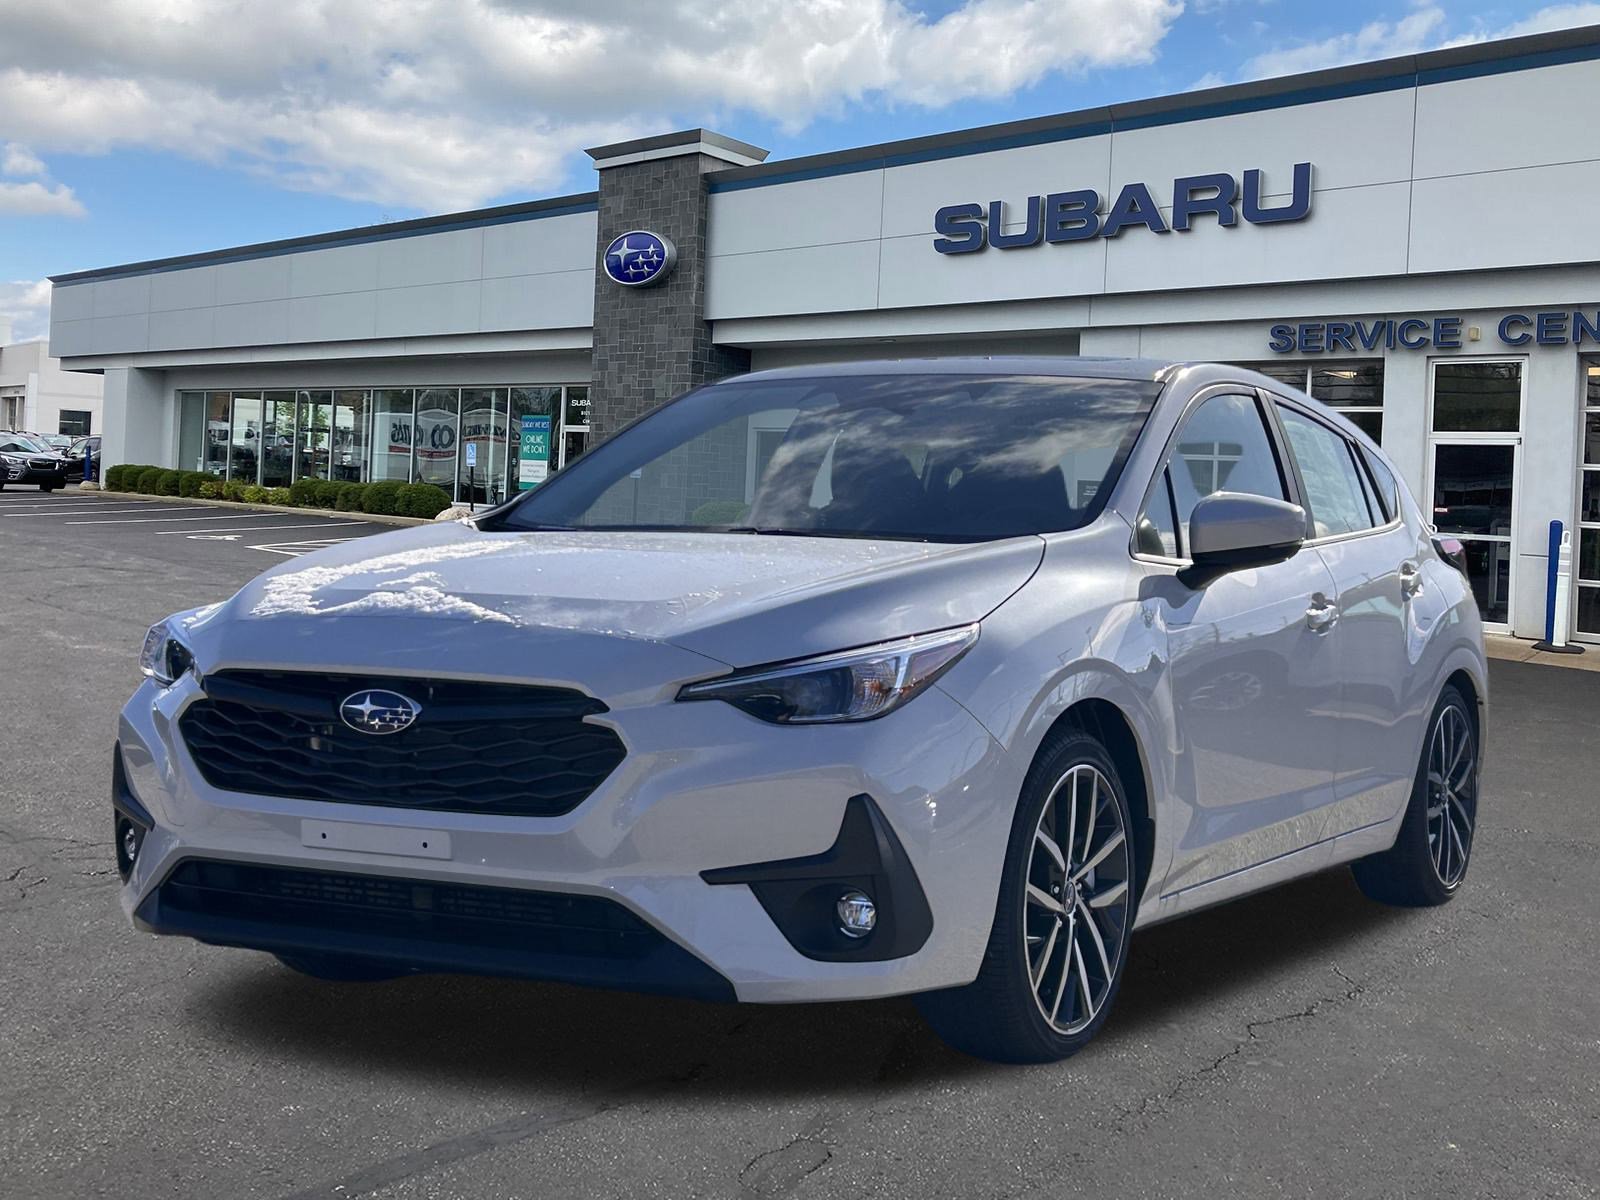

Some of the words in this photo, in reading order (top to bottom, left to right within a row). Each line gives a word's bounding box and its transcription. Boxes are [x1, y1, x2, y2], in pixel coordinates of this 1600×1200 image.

[933, 161, 1313, 255] SUBARU
[1269, 316, 1463, 353] SERVICE
[1497, 310, 1600, 347] CEN
